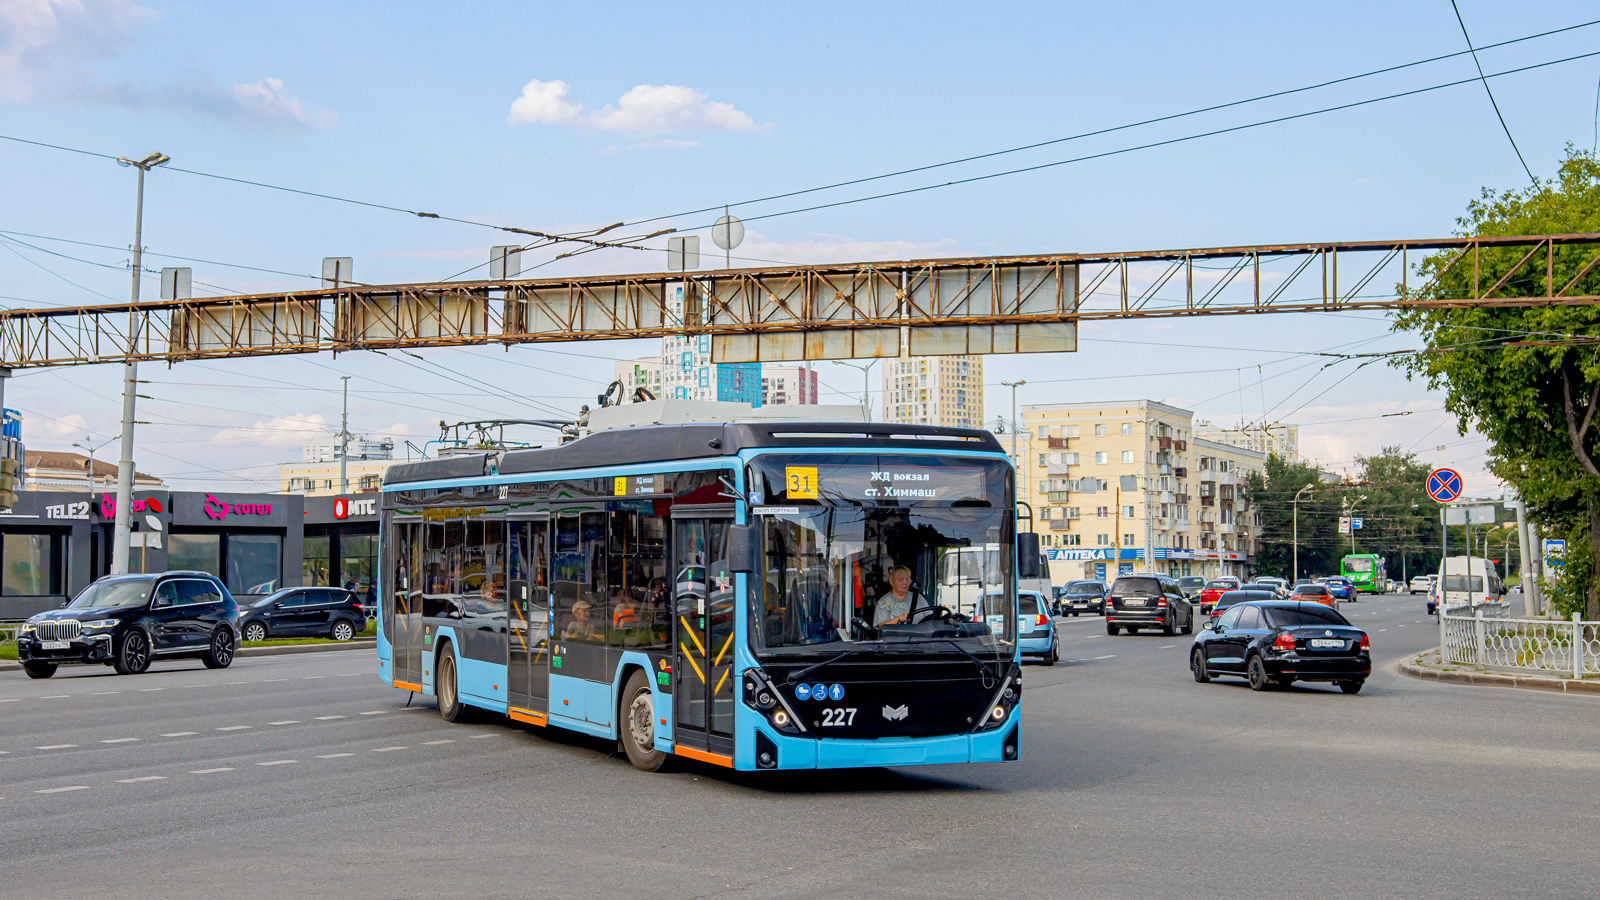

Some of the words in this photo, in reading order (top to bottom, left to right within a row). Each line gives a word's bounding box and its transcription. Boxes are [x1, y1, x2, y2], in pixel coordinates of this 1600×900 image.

[790, 474, 811, 492] 31
[870, 472, 890, 482] ЖД
[893, 473, 930, 481] вокзал
[499, 486, 508, 499] 227
[864, 488, 881, 496] ст.
[884, 486, 936, 497] Химмаш
[45, 501, 90, 520] TELE2
[234, 503, 273, 515] сотел
[347, 499, 376, 516] МТС
[1055, 549, 1106, 560] АПТЕКА
[822, 708, 858, 726] 227
